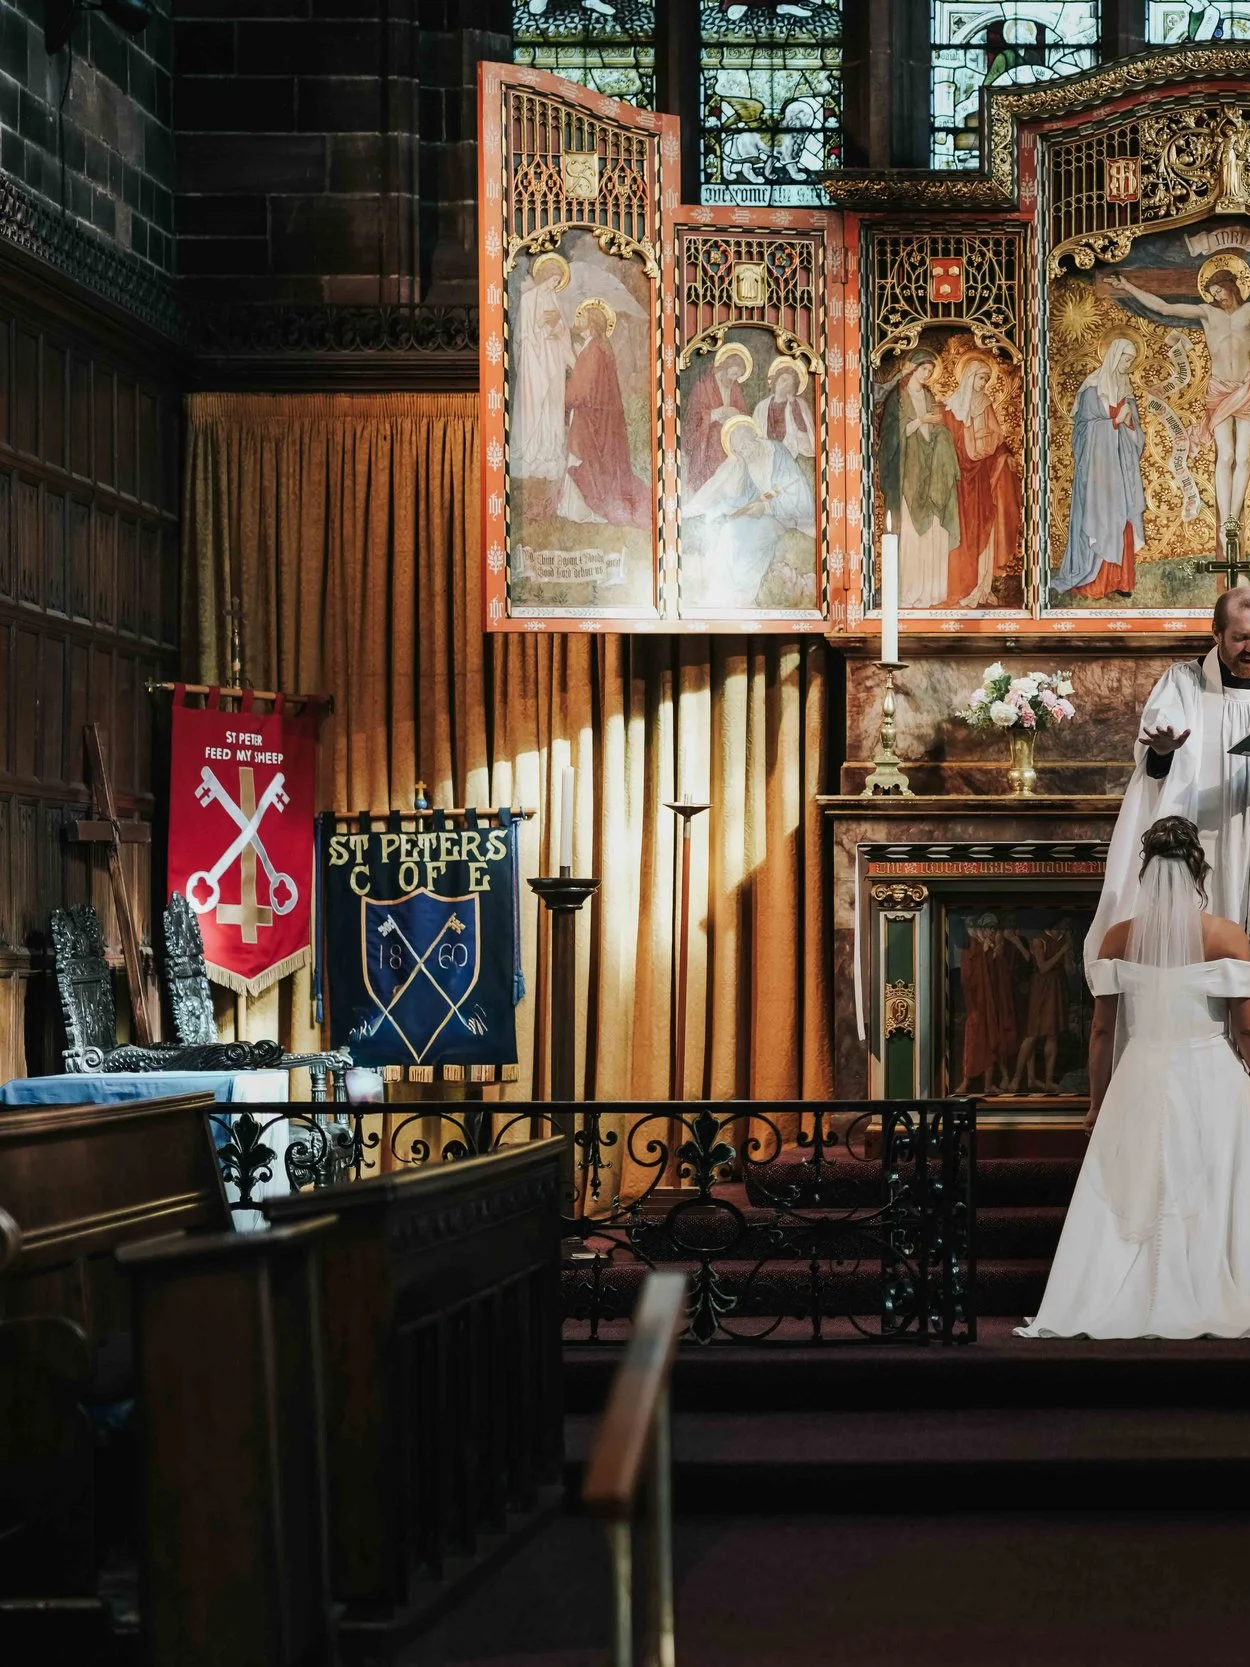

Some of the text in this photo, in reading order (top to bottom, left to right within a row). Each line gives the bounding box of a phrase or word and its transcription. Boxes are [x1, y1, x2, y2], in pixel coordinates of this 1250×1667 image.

[226, 730, 263, 746] ST PETER
[205, 746, 284, 765] FEED MY SHEEP
[328, 829, 509, 866] ST PETERS
[349, 866, 371, 896] C
[468, 862, 492, 892] E
